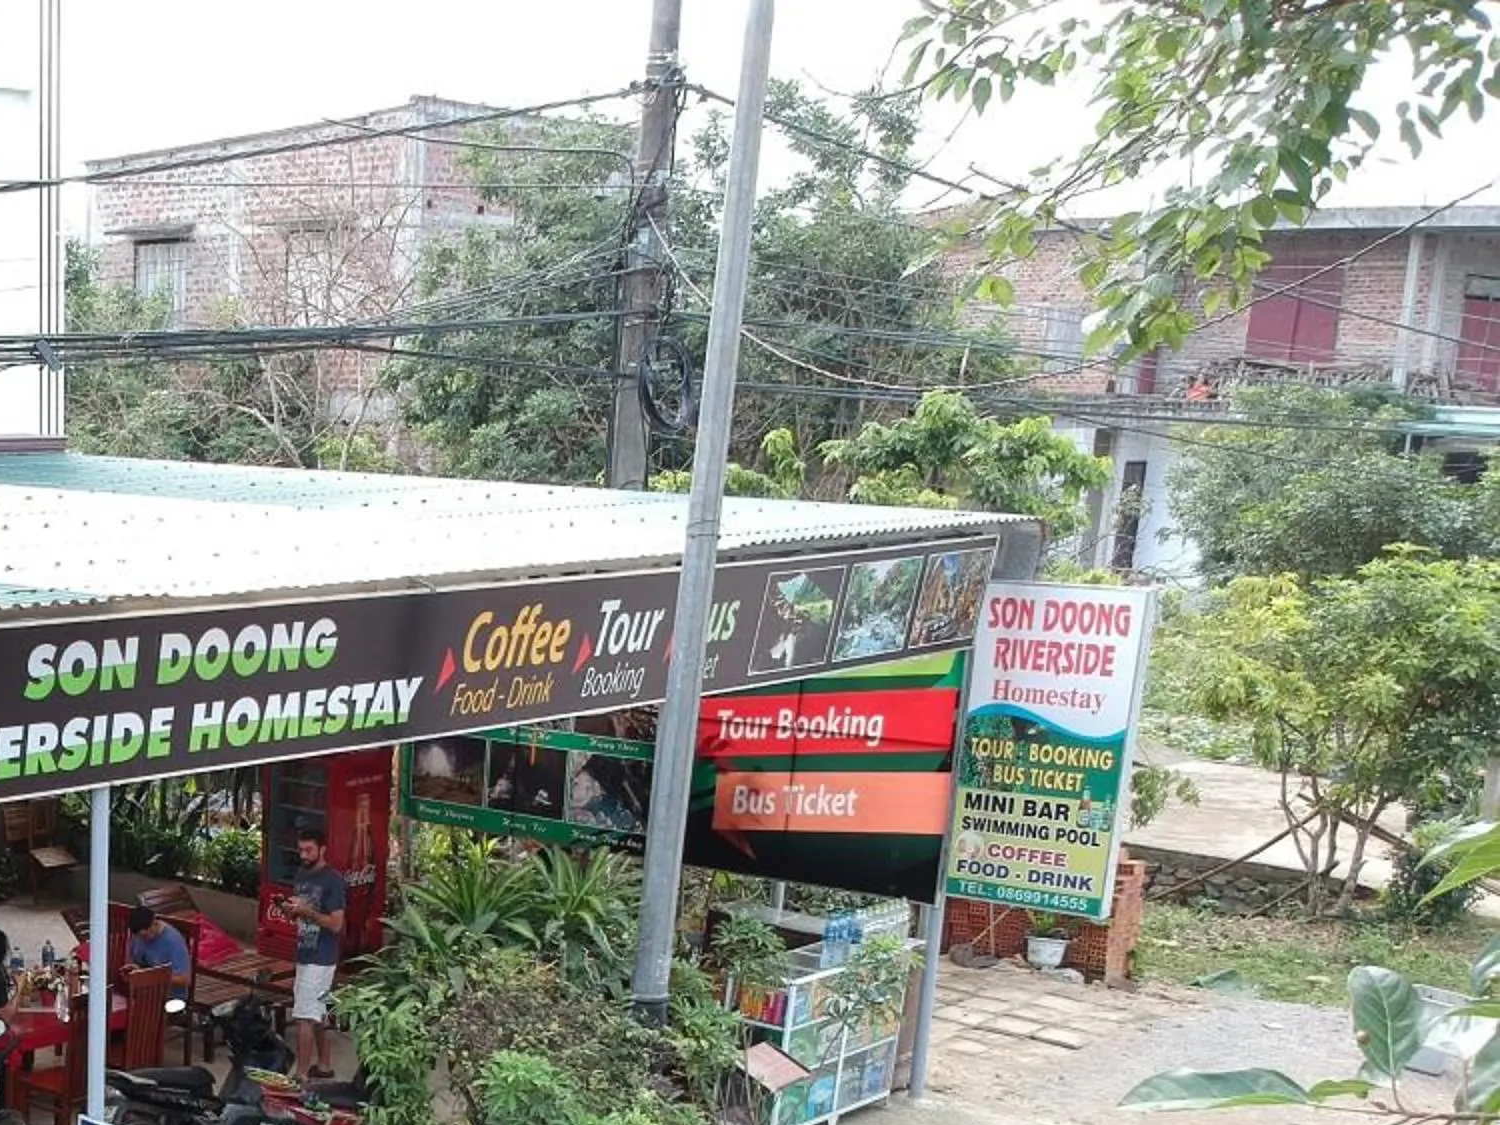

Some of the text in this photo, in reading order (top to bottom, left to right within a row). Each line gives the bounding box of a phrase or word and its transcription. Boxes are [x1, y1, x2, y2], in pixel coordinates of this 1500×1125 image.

[988, 597, 1132, 638] SON DOONG
[463, 599, 741, 673] Coffee Tour us
[24, 617, 339, 700] SON DOONG
[993, 637, 1116, 677] RIVERSIDE
[450, 678, 498, 717] Food
[506, 672, 555, 710] Drink
[581, 662, 645, 699] Booking
[992, 679, 1107, 715] Homestay
[188, 676, 425, 753] HOMESTAY
[717, 706, 884, 747] Tour Booking
[970, 737, 1114, 771] TOUR BOOKING
[992, 763, 1084, 793] BUS TICKET
[732, 784, 859, 817] Bus Ticket
[964, 791, 1070, 822] MINI BAR
[961, 815, 1101, 847] SWIMMING POOL
[987, 843, 1067, 868] COFFEE
[956, 859, 1010, 879] FOOD
[1027, 869, 1094, 892] DRINK
